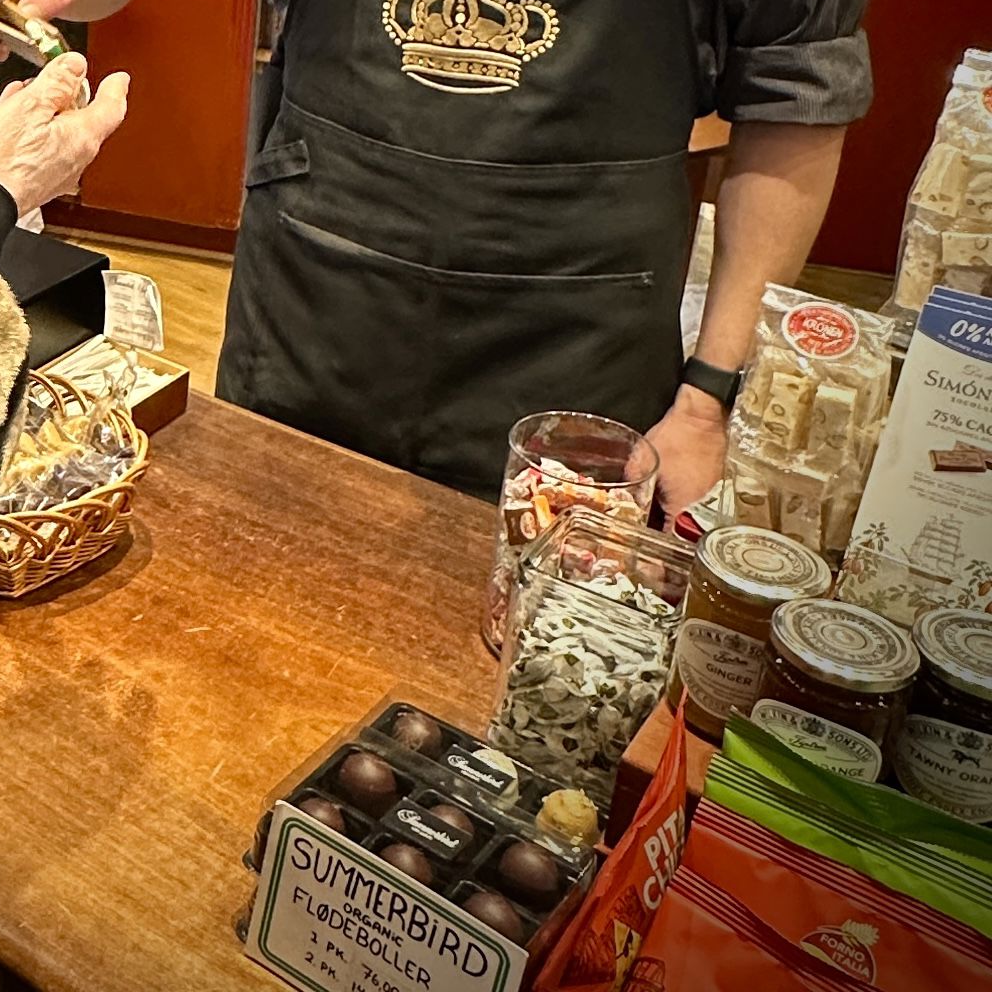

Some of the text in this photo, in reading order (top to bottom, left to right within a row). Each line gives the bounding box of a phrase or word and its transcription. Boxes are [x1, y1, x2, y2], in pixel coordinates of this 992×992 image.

[950, 319, 985, 342] 0%
[933, 409, 962, 427] 75%
[706, 663, 753, 686] GINGER
[909, 746, 957, 775] TAWNY
[293, 886, 431, 990] FLØDEBOLLER
[819, 932, 865, 962] FORNO
[831, 951, 870, 978] ITALIA
